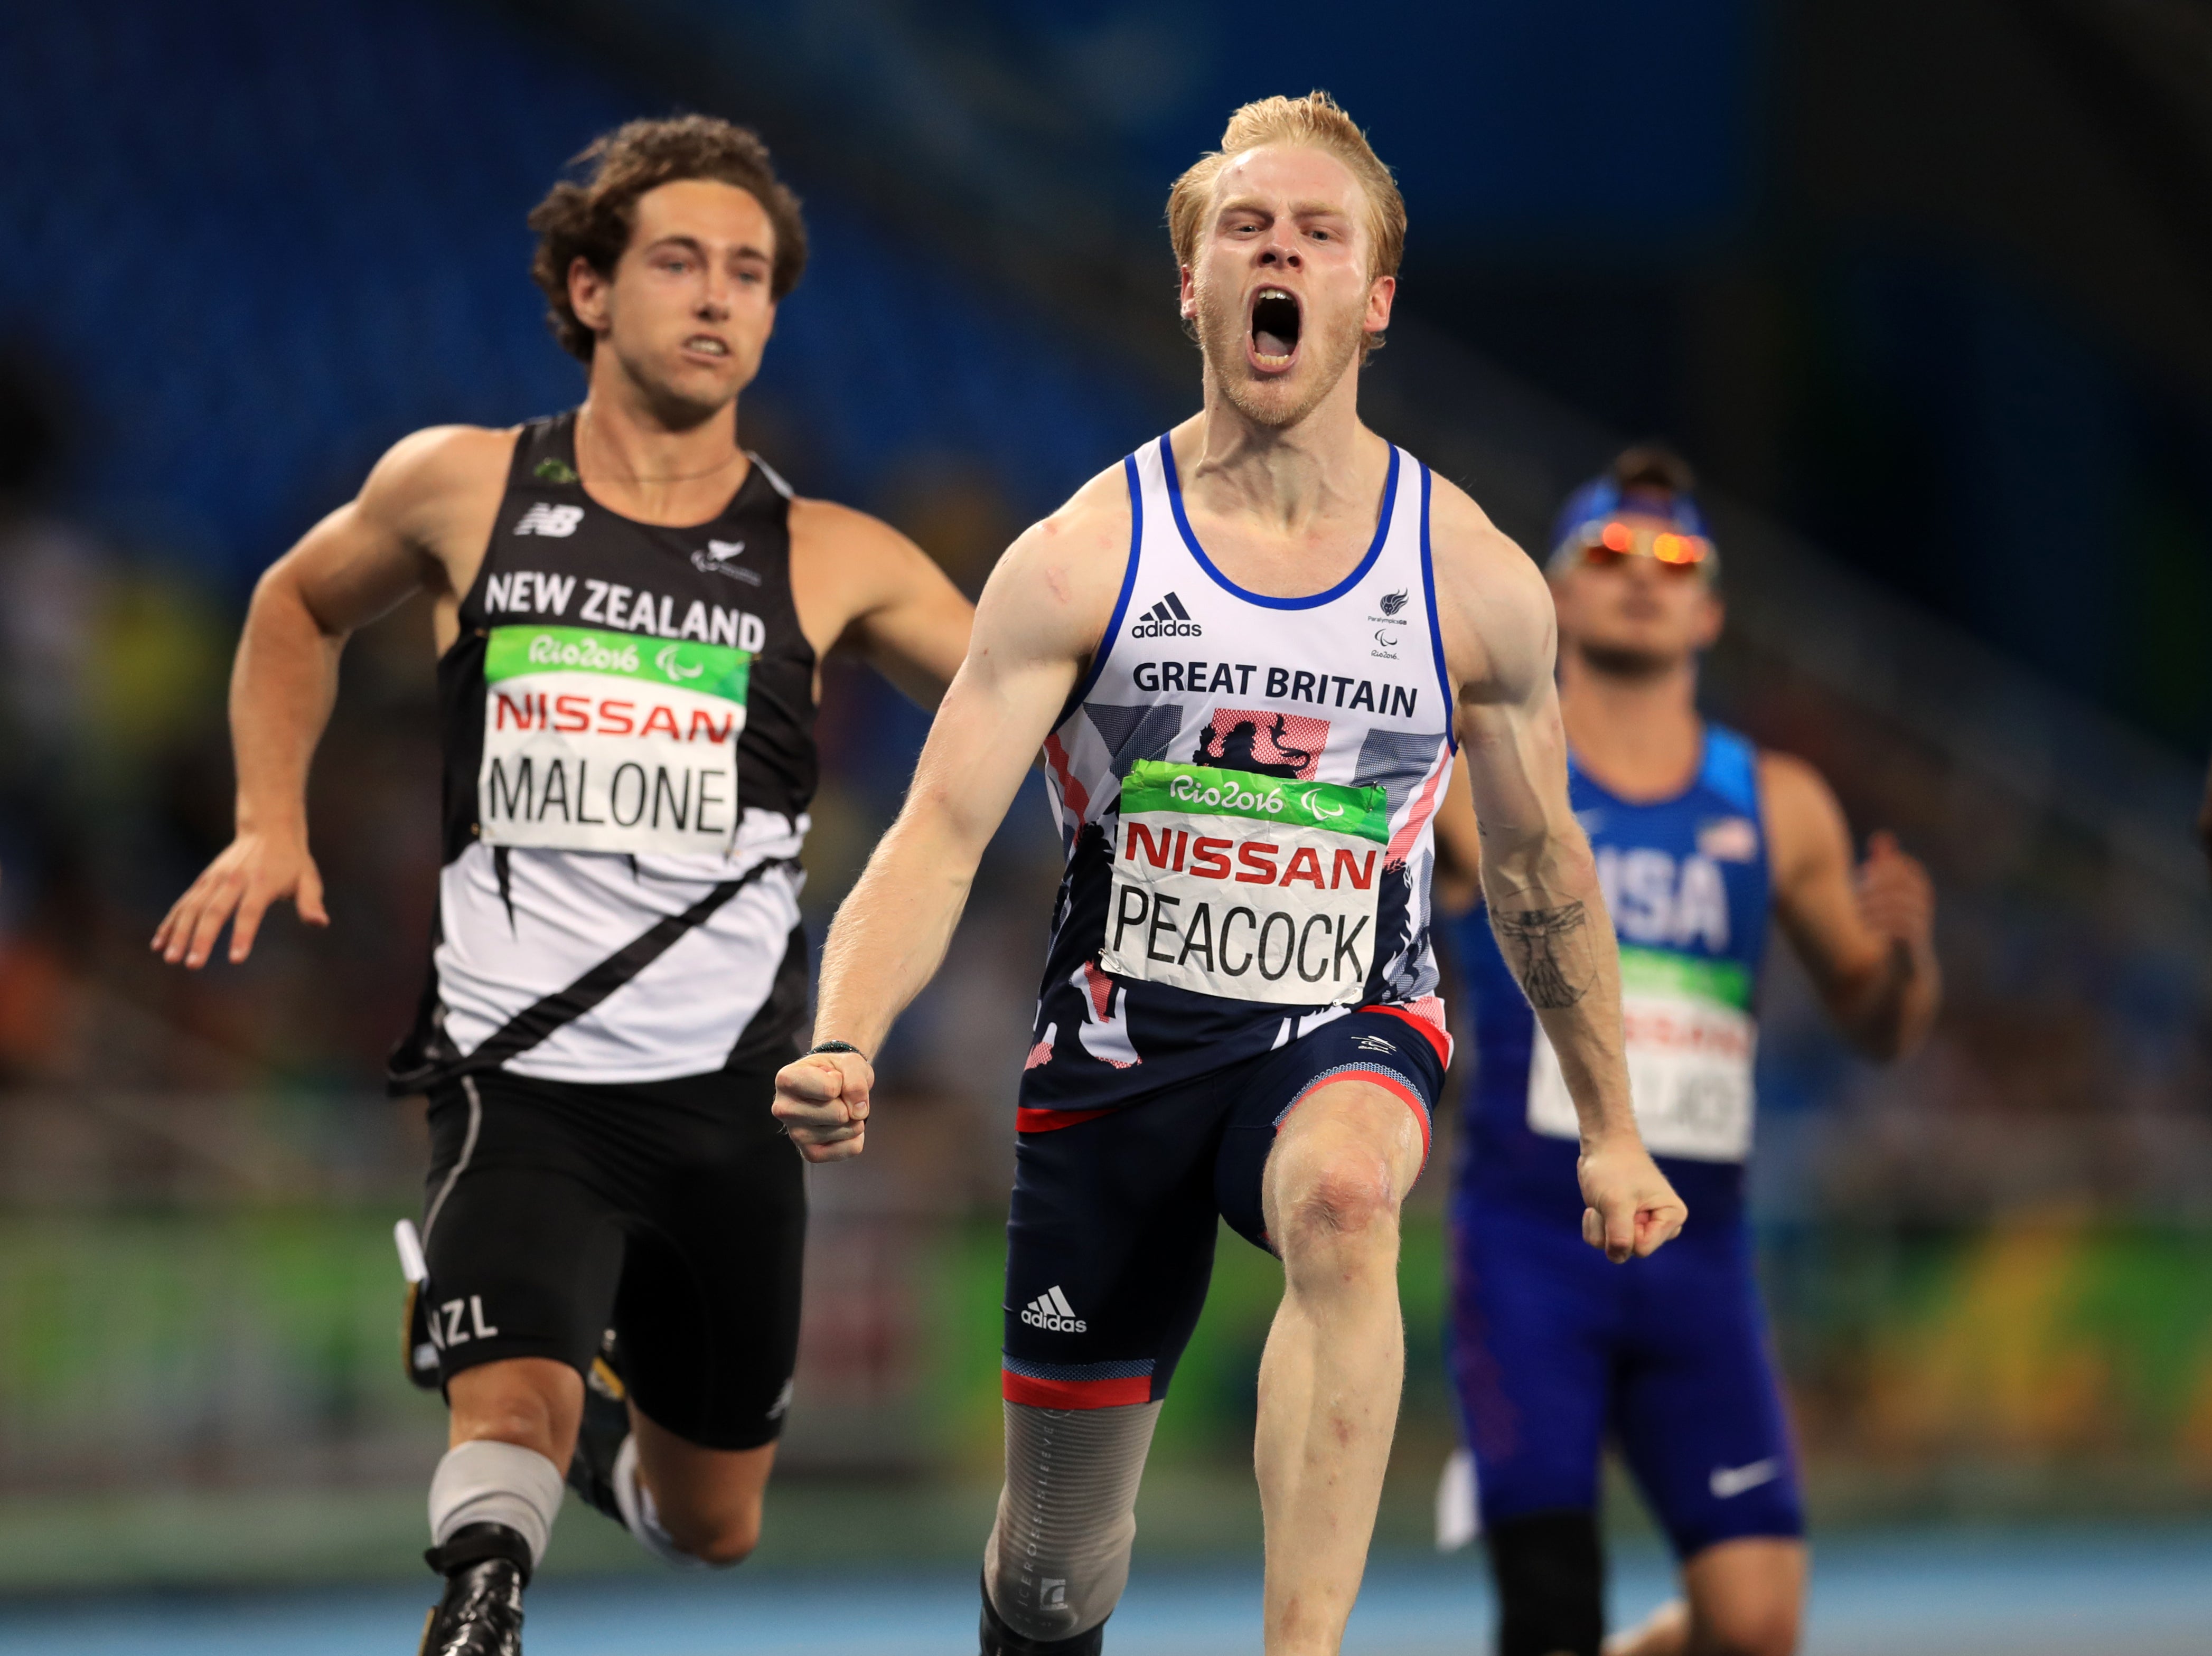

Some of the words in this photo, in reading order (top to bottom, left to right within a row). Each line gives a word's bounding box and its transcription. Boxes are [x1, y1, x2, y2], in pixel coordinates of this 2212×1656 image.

[485, 571, 577, 615] NEW
[580, 579, 765, 653] ZEALAND
[1132, 620, 1202, 638] adidas
[529, 636, 639, 672] Rio2016
[1133, 662, 1257, 694] GREAT
[1265, 667, 1417, 717] BRITAIN
[497, 693, 732, 744] NISSAN
[490, 758, 726, 834] MALONE
[1170, 775, 1283, 813] Rio2016
[1125, 822, 1376, 890] NISSAN
[1113, 884, 1370, 982] PEACOCK
[1021, 1310, 1087, 1333] adidas
